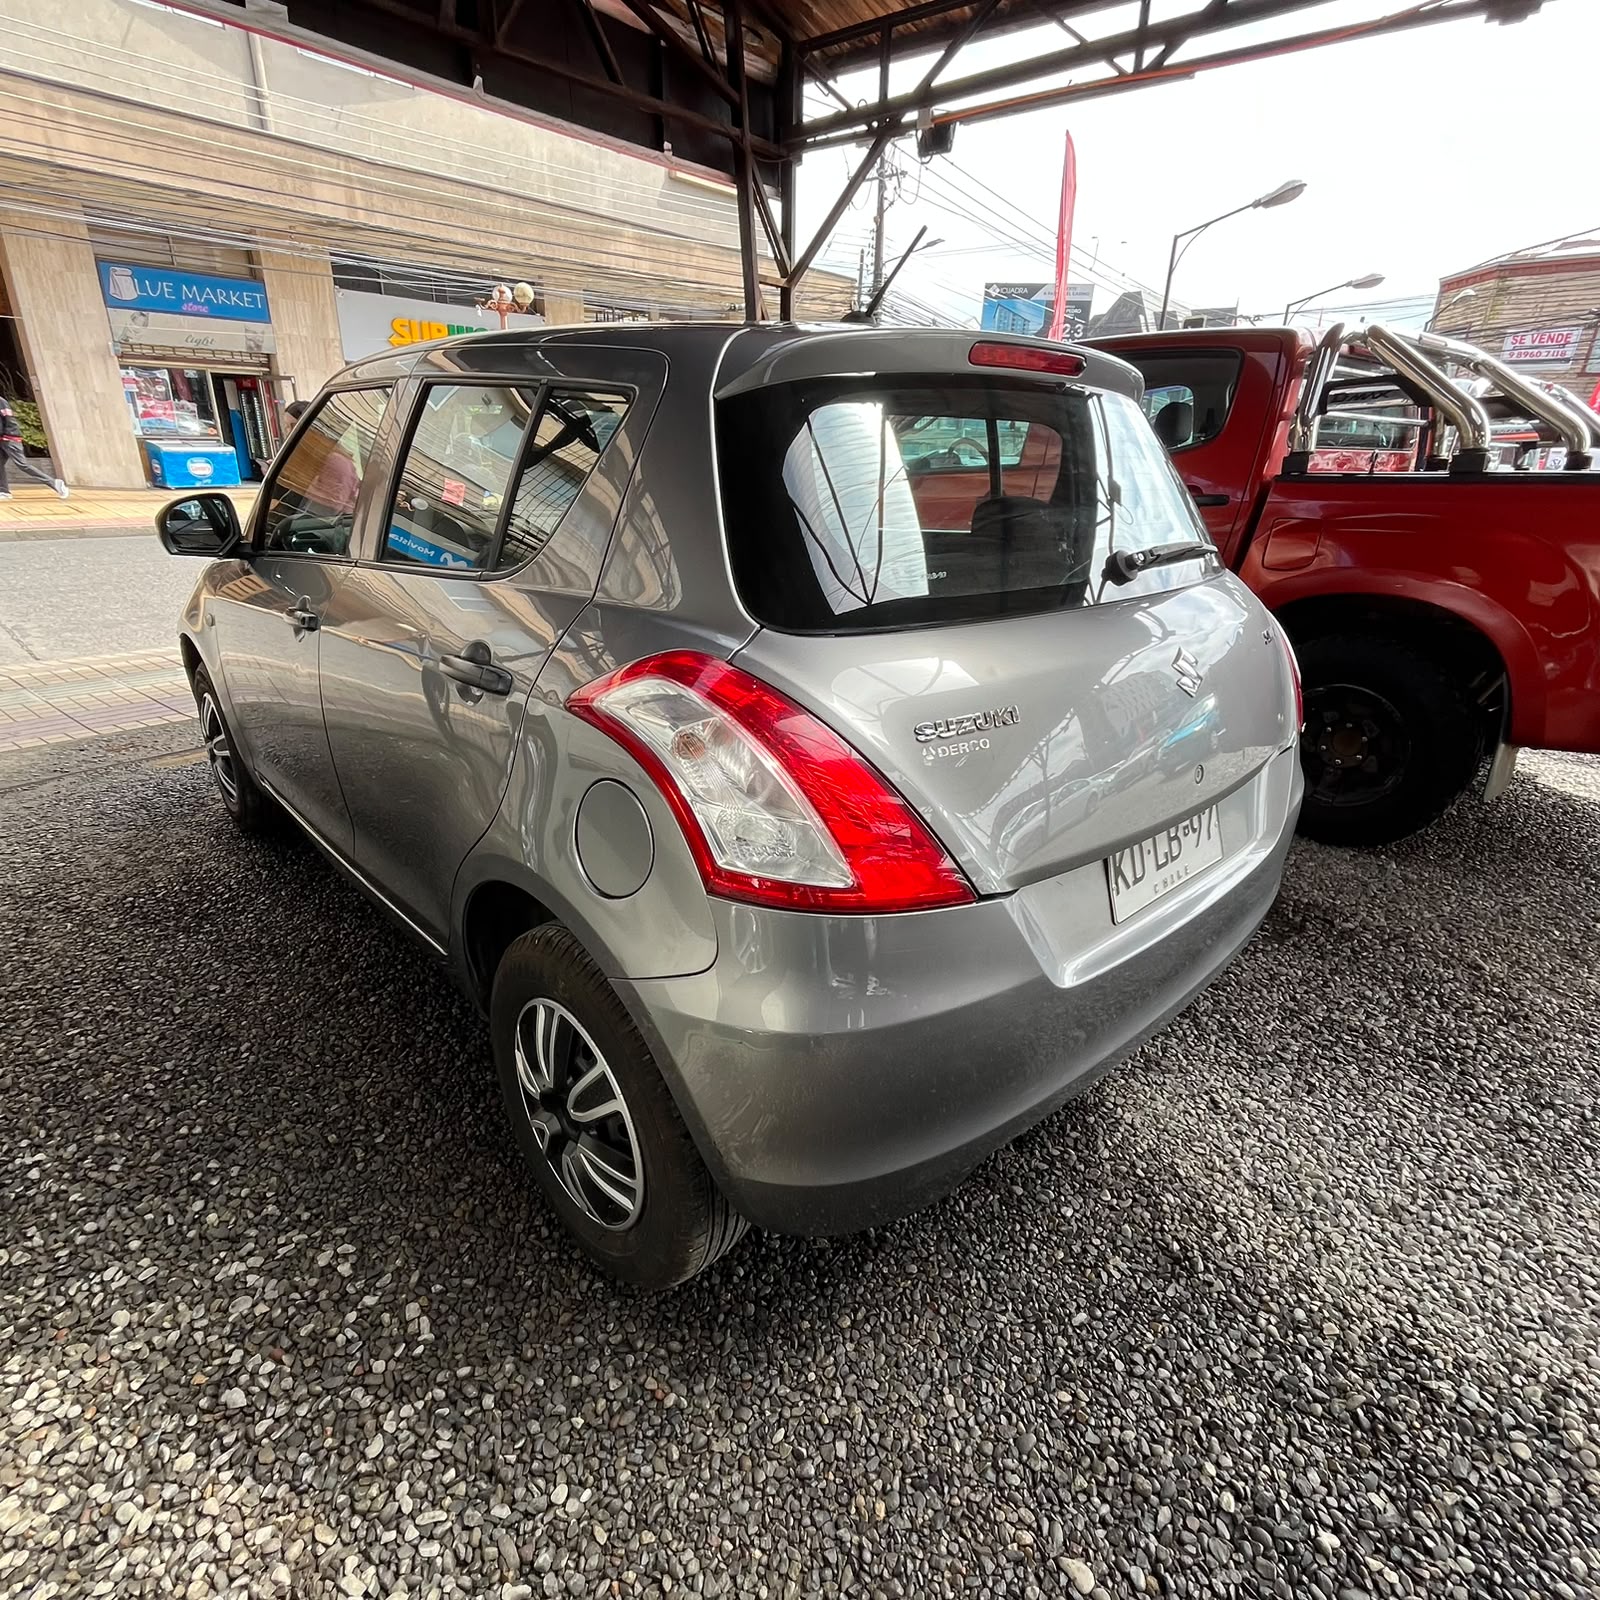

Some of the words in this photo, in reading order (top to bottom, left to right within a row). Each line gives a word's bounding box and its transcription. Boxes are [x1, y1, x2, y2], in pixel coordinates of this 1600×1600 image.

[181, 302, 210, 314] store
[182, 284, 265, 310] MARKET
[1511, 335, 1527, 346] SE
[1531, 333, 1573, 345] VENDE
[914, 705, 1021, 743] SUZUKI
[937, 738, 990, 758] DERCO
[1153, 864, 1190, 894] CHILE
